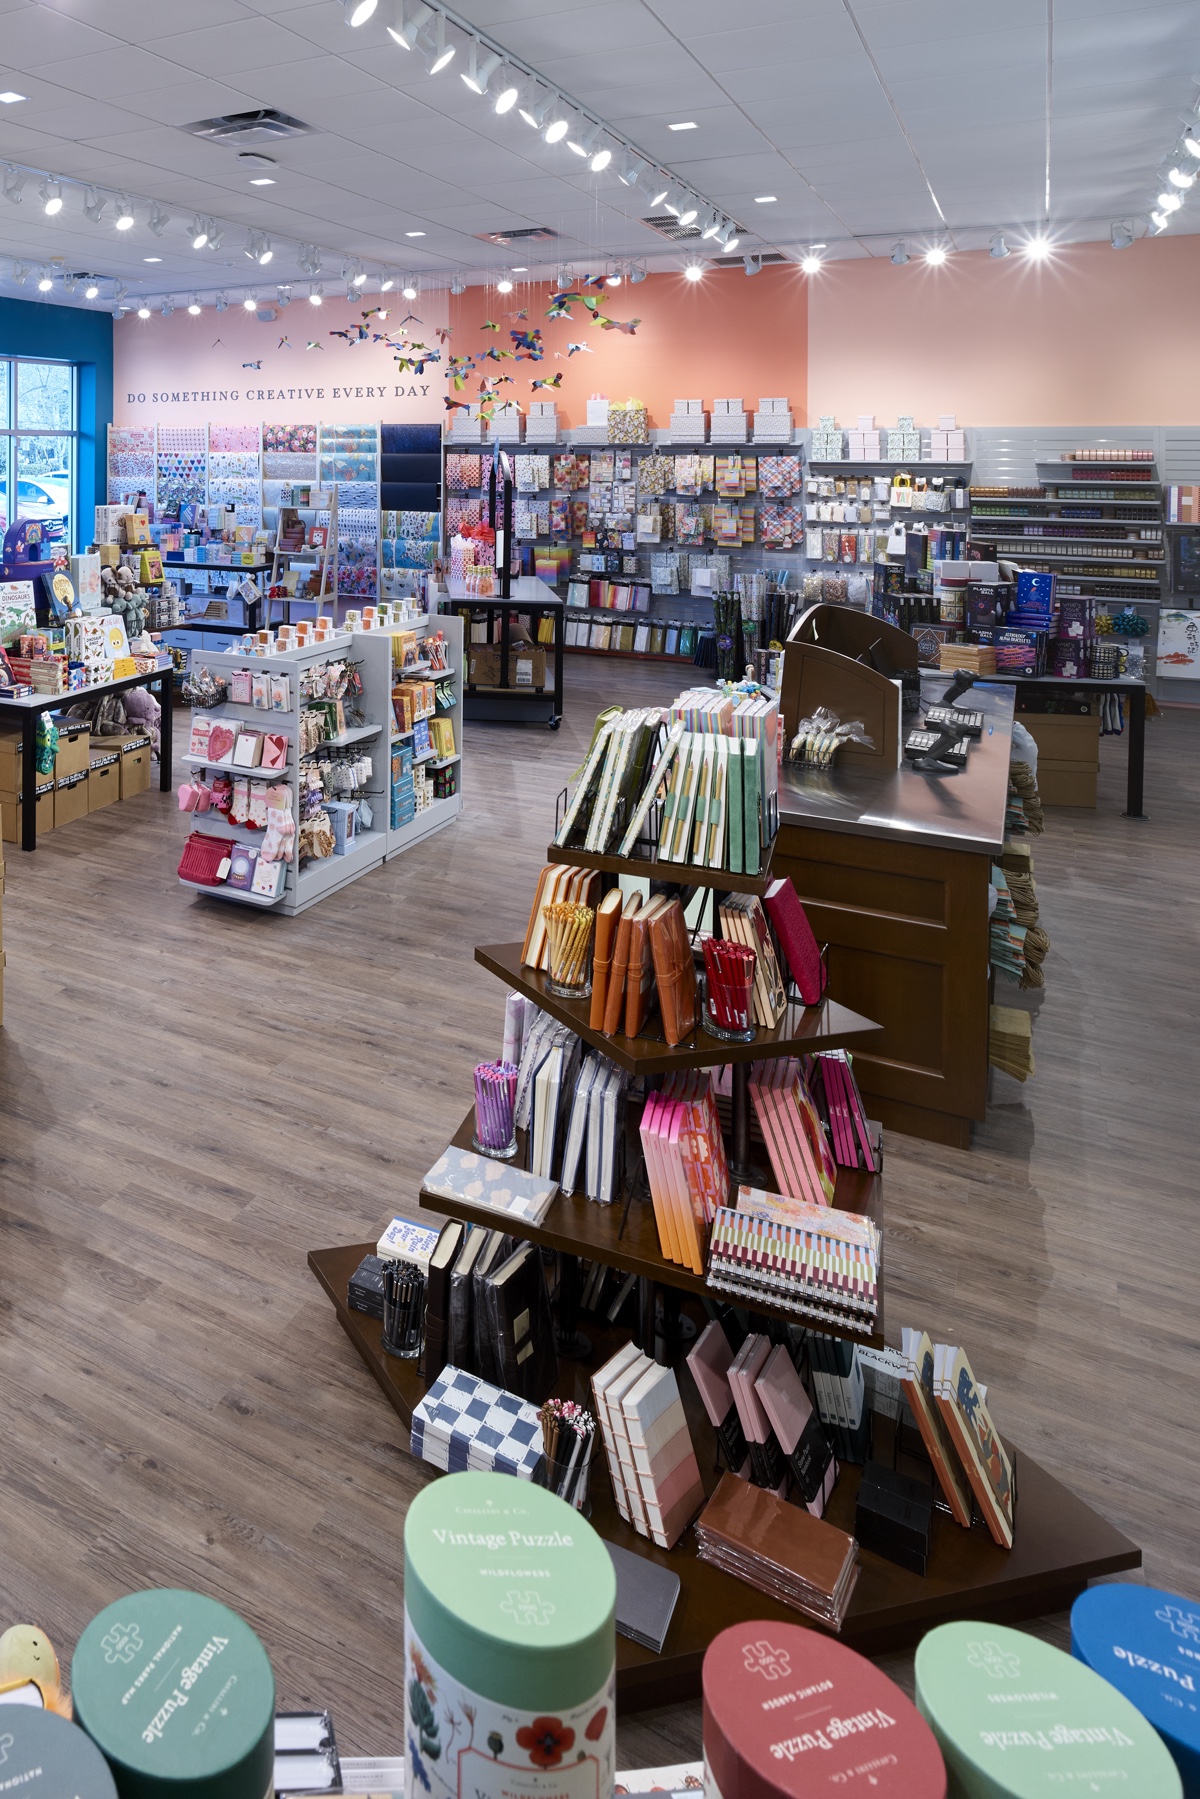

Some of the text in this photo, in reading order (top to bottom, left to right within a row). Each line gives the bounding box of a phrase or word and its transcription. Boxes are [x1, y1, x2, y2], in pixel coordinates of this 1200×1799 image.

[127, 385, 431, 403] DO SOMETHING CREATIVE EVERY DAY
[896, 492, 911, 504] YAY
[386, 1226, 402, 1244] Day!
[401, 1225, 416, 1241] Your
[408, 1235, 424, 1252] Ruin
[858, 1349, 901, 1371] BLACKW
[432, 1529, 574, 1550] Vintage Puzzle
[479, 1568, 551, 1577] WILDFLOWERS
[121, 1625, 183, 1705] NATIONAL PARKS MAP
[1112, 1646, 1196, 1692] Puzzle
[142, 1636, 229, 1744] Vintage Puzzle
[762, 1679, 834, 1710] BOTANIC GARDEN
[987, 1692, 1060, 1703] WILDFLOWERS
[770, 1708, 896, 1761] Vintage Puzzle
[980, 1724, 1135, 1750] Vintage Puzzle
